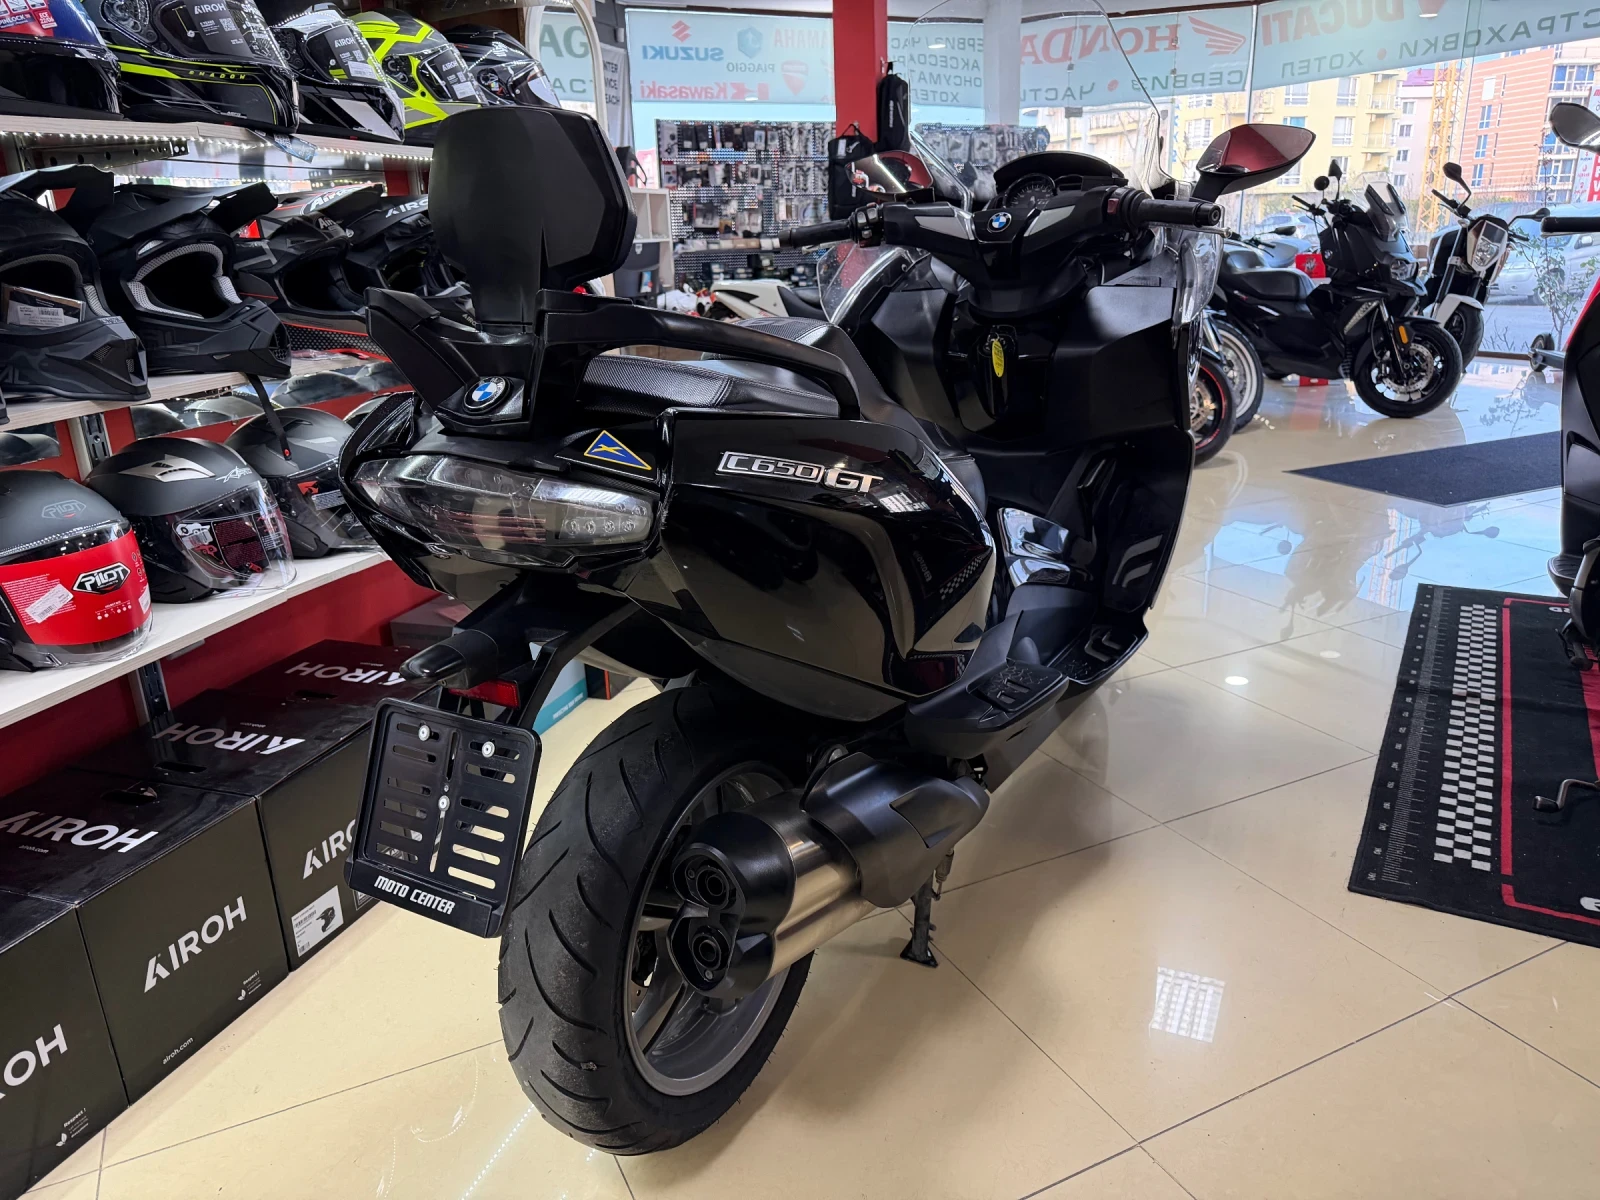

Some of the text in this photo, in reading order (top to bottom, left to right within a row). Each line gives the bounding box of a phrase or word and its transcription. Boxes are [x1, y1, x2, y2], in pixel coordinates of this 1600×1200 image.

[194, 3, 226, 15] AIROH
[188, 70, 246, 80] SHADOW
[823, 468, 884, 493] GT
[152, 722, 305, 755] AIROH
[0, 810, 159, 853] AIROH
[373, 875, 456, 915] MOTO CENTER
[143, 896, 248, 993] AIROH
[0, 1024, 68, 1099] OH
[162, 1036, 194, 1065] airoh.com
